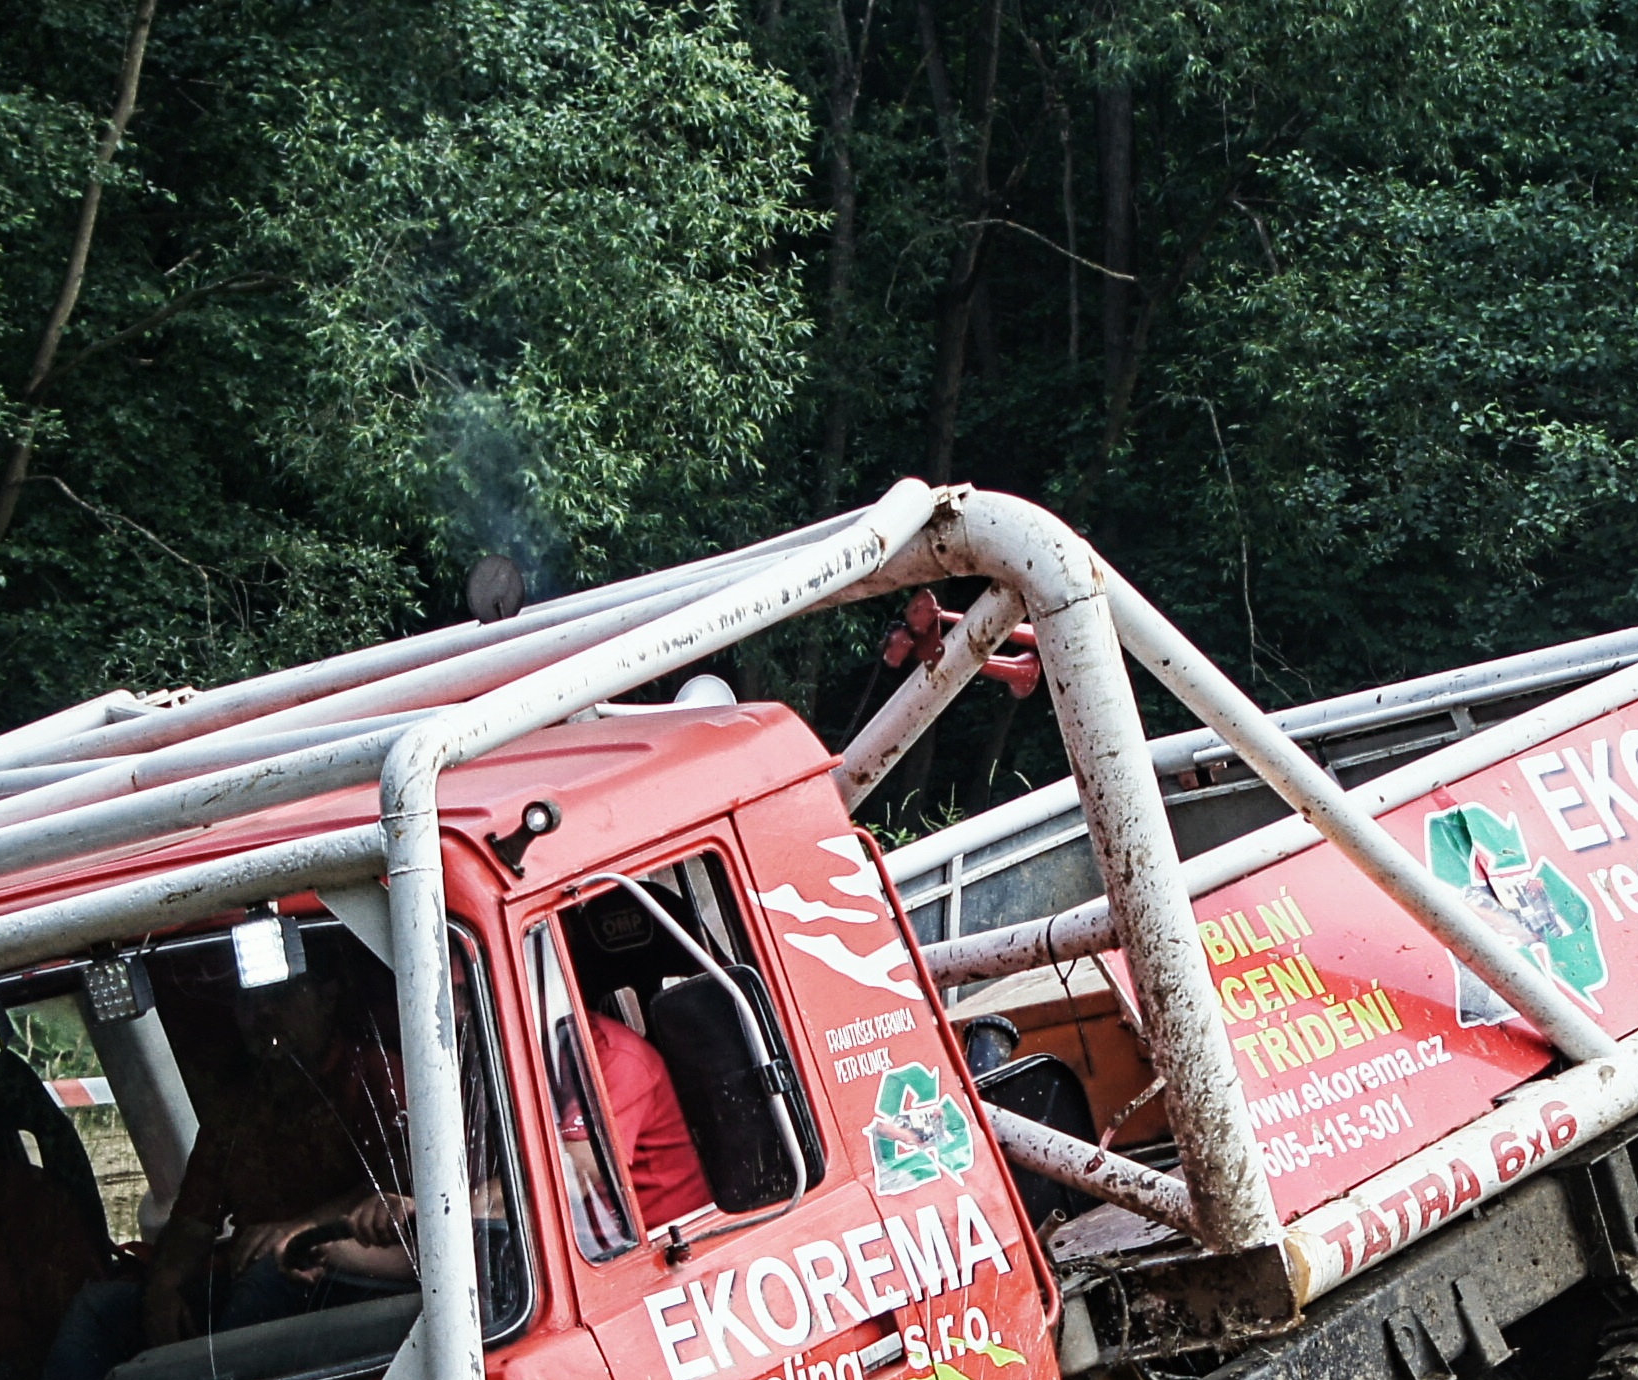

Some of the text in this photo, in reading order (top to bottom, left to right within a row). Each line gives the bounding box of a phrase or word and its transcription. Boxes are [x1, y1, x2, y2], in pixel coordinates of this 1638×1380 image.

[1197, 885, 1313, 966] BILNÍ
[1214, 942, 1327, 1026] CENÍ
[825, 1016, 877, 1054] FRANTIŠEK
[833, 1055, 861, 1084] PETR
[1232, 978, 1403, 1079] TŘÍDĚNÍ
[1256, 1093, 1414, 1178] 605-415-301
[1321, 1100, 1578, 1277] TATRA 6x6
[904, 1305, 1003, 1371] s.r.o.
